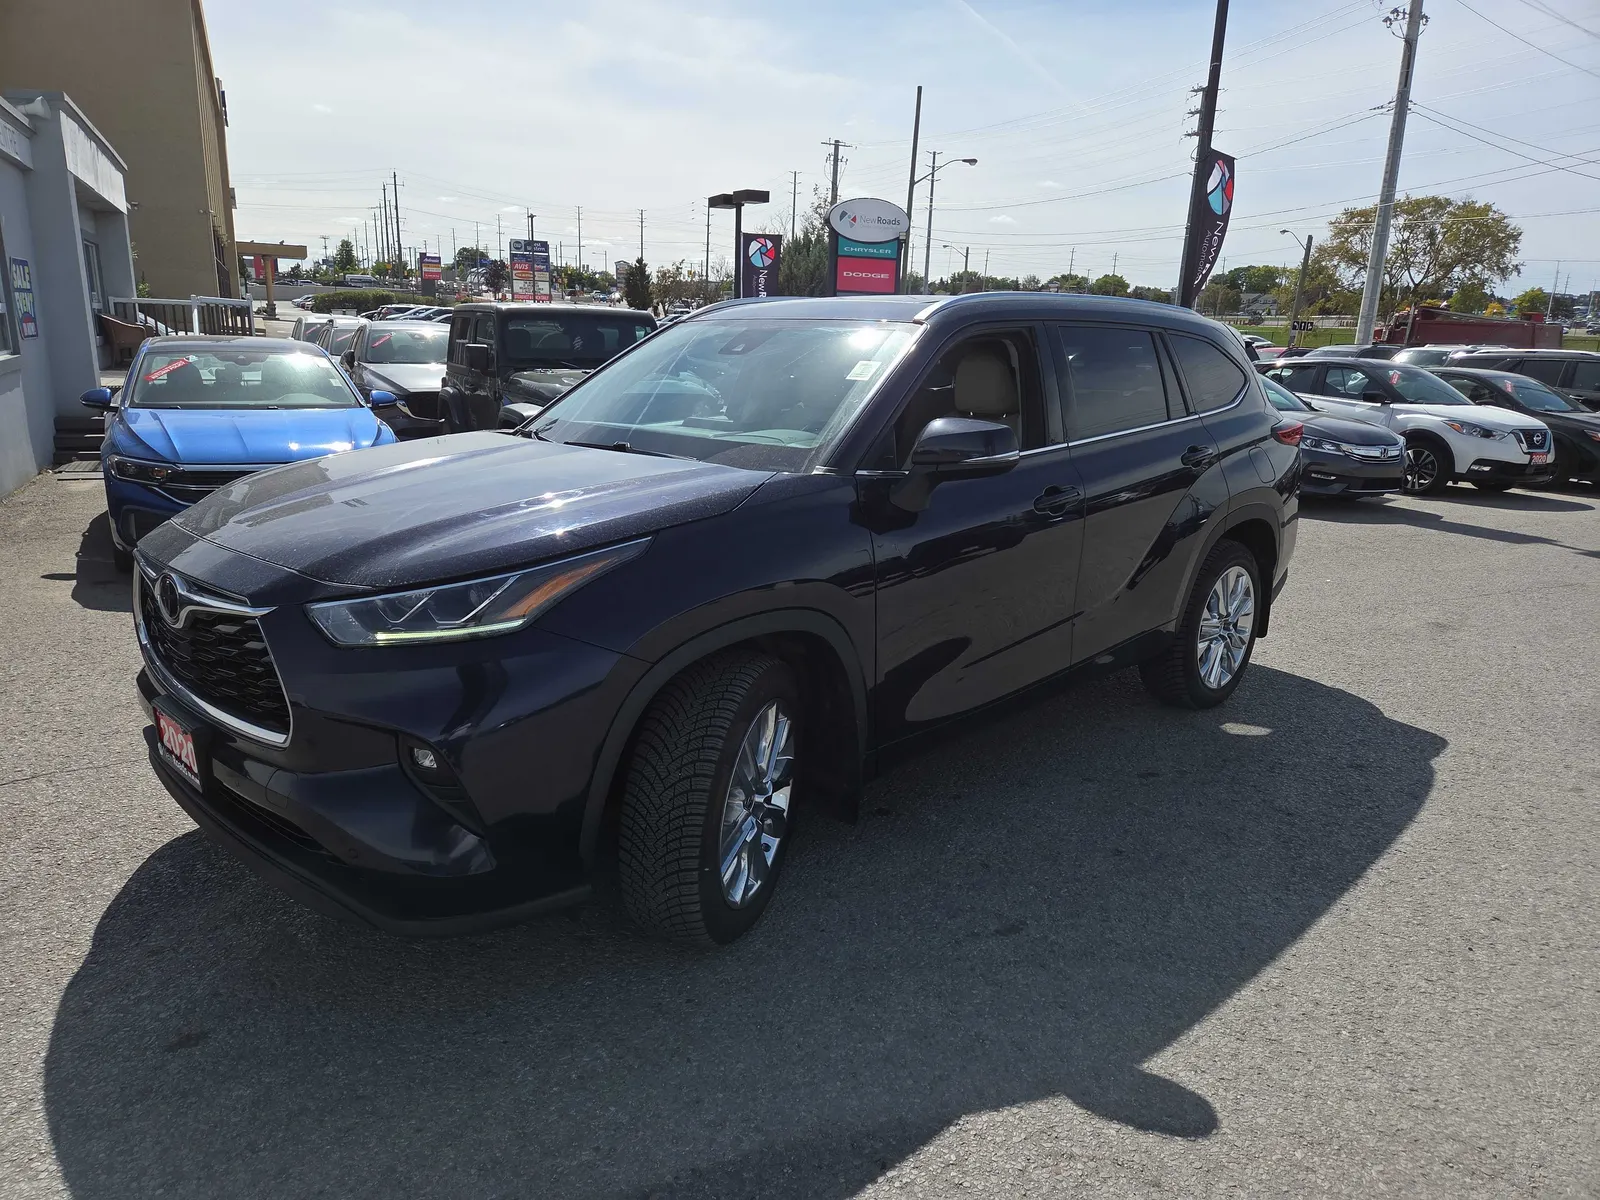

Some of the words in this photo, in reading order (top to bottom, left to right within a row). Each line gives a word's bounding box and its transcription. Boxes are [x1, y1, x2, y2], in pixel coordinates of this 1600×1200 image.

[860, 214, 901, 225] NewRoads
[843, 246, 892, 254] CHRYSLER
[12, 264, 31, 289] SALE
[843, 271, 890, 279] DODGE
[160, 718, 198, 774] 2020
